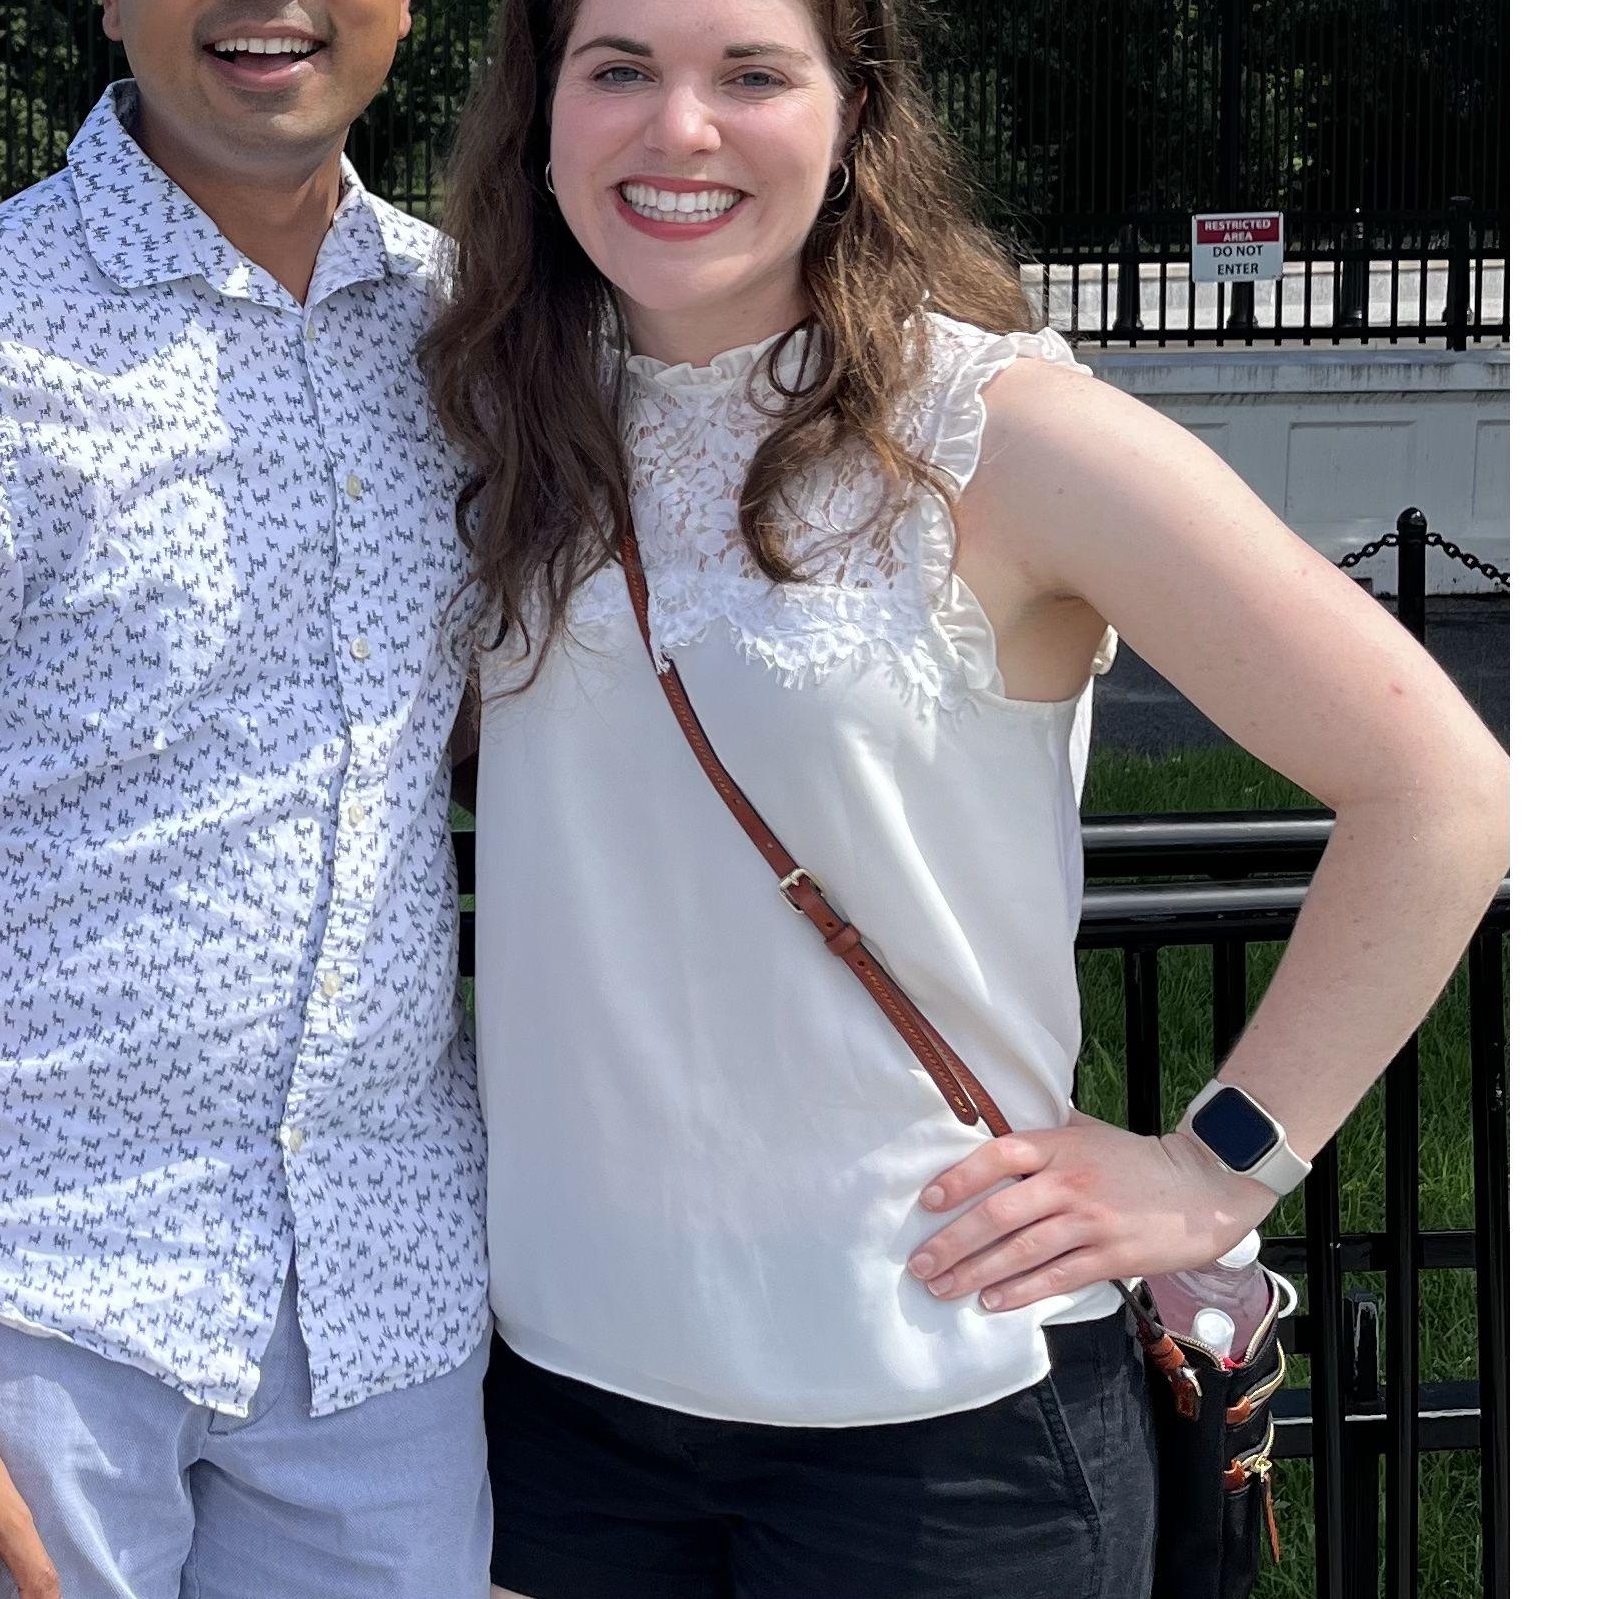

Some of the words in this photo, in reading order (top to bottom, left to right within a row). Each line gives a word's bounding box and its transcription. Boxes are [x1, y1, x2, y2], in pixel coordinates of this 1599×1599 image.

[1205, 219, 1271, 231] RESTRICTED
[1223, 231, 1253, 242] AREA
[1213, 246, 1232, 257] DO
[1236, 245, 1263, 256] NOT
[1217, 263, 1259, 275] ENTER
